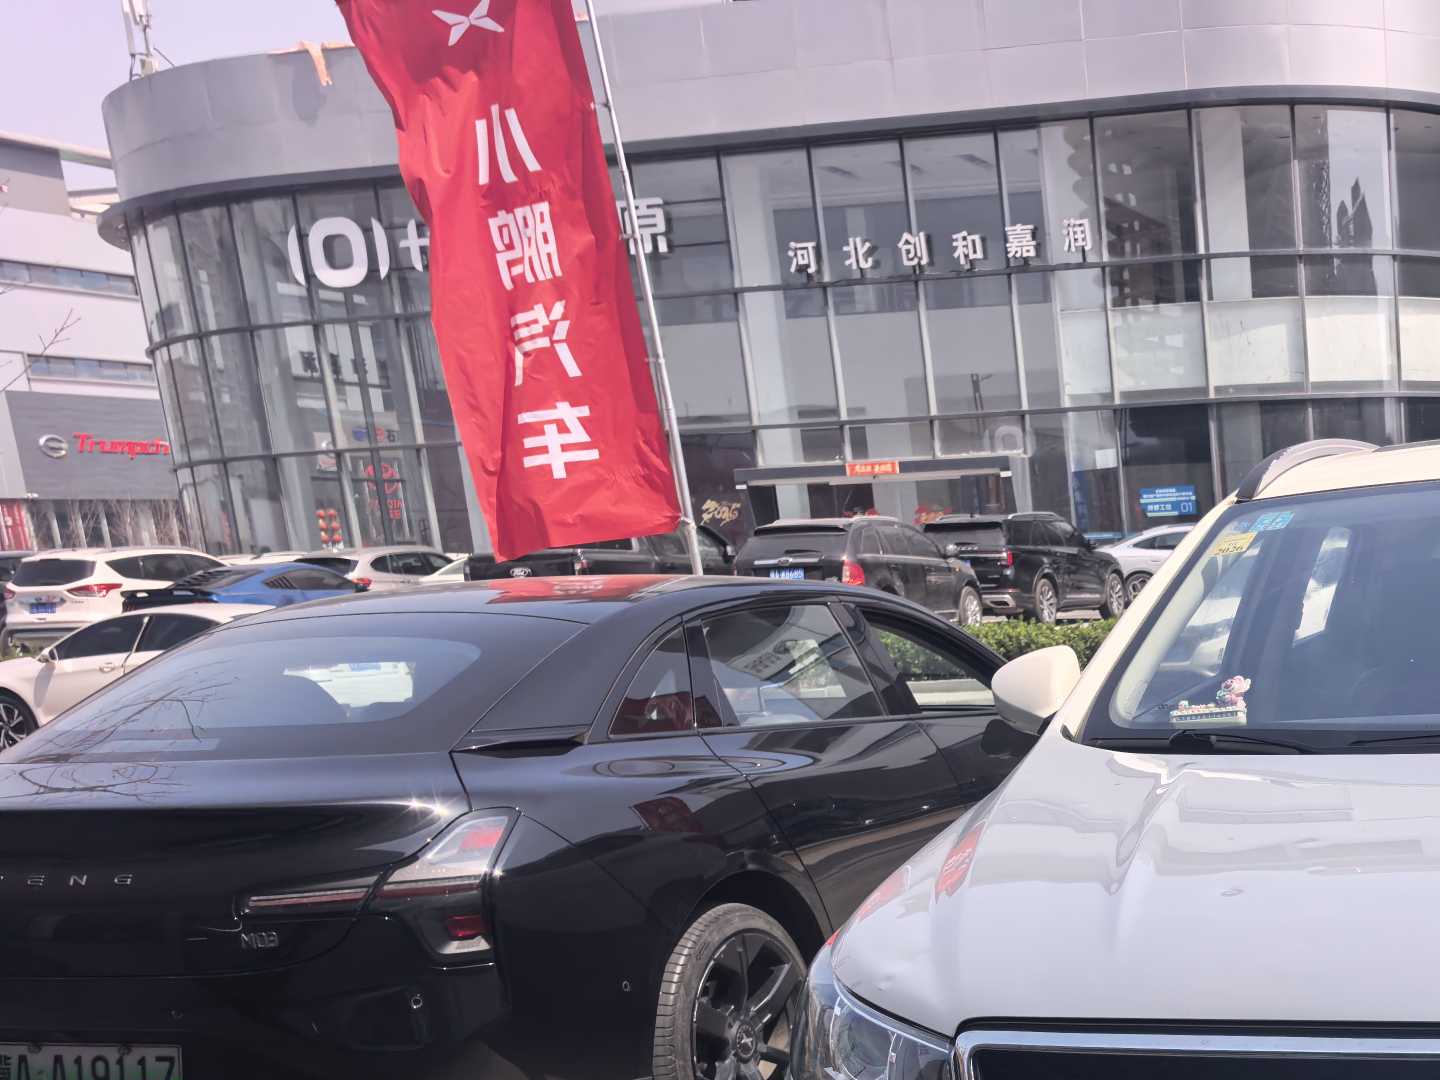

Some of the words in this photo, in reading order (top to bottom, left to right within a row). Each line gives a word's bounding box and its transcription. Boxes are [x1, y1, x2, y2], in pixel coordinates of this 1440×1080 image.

[787, 217, 1093, 275] 河北创和嘉润
[73, 432, 171, 460] Trumpch
[0, 874, 133, 887] ENG
